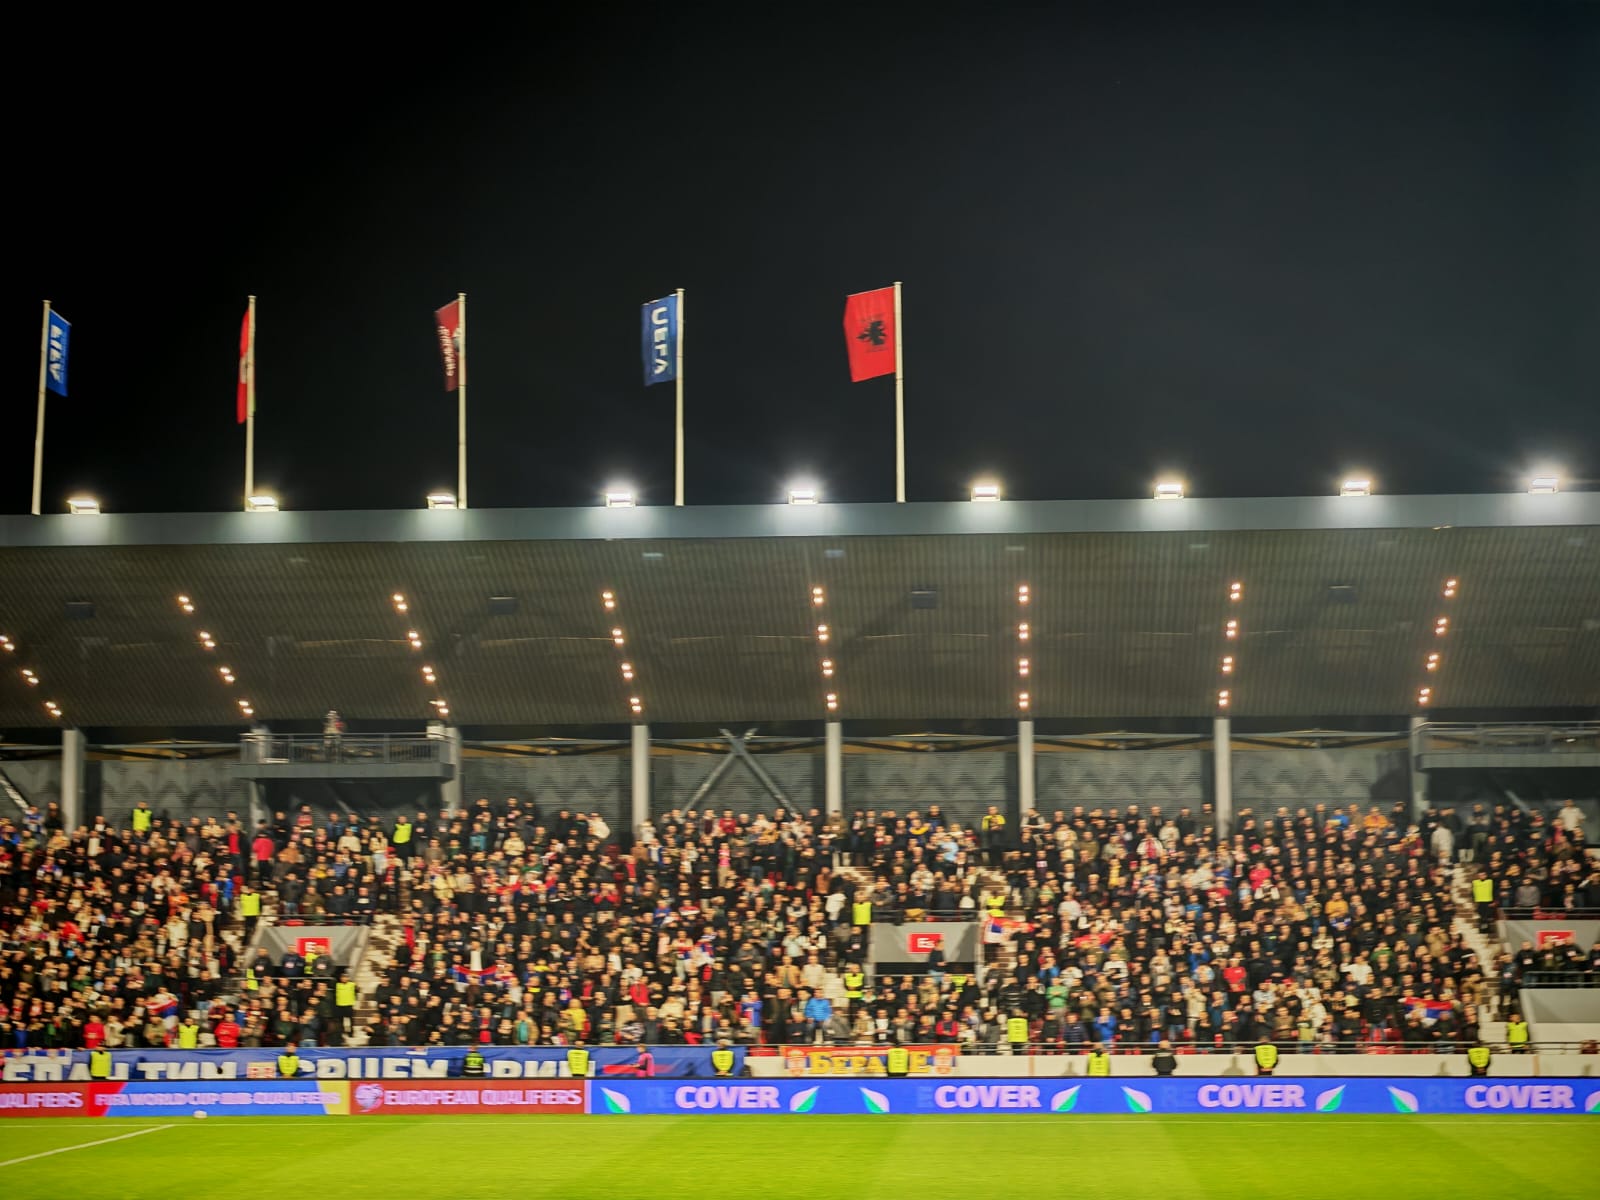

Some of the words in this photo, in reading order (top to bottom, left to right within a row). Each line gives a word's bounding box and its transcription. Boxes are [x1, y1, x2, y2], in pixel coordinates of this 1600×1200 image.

[651, 306, 669, 375] UEFA
[383, 1089, 479, 1106] EUROPEAN
[481, 1089, 583, 1105] QUALIFIERS
